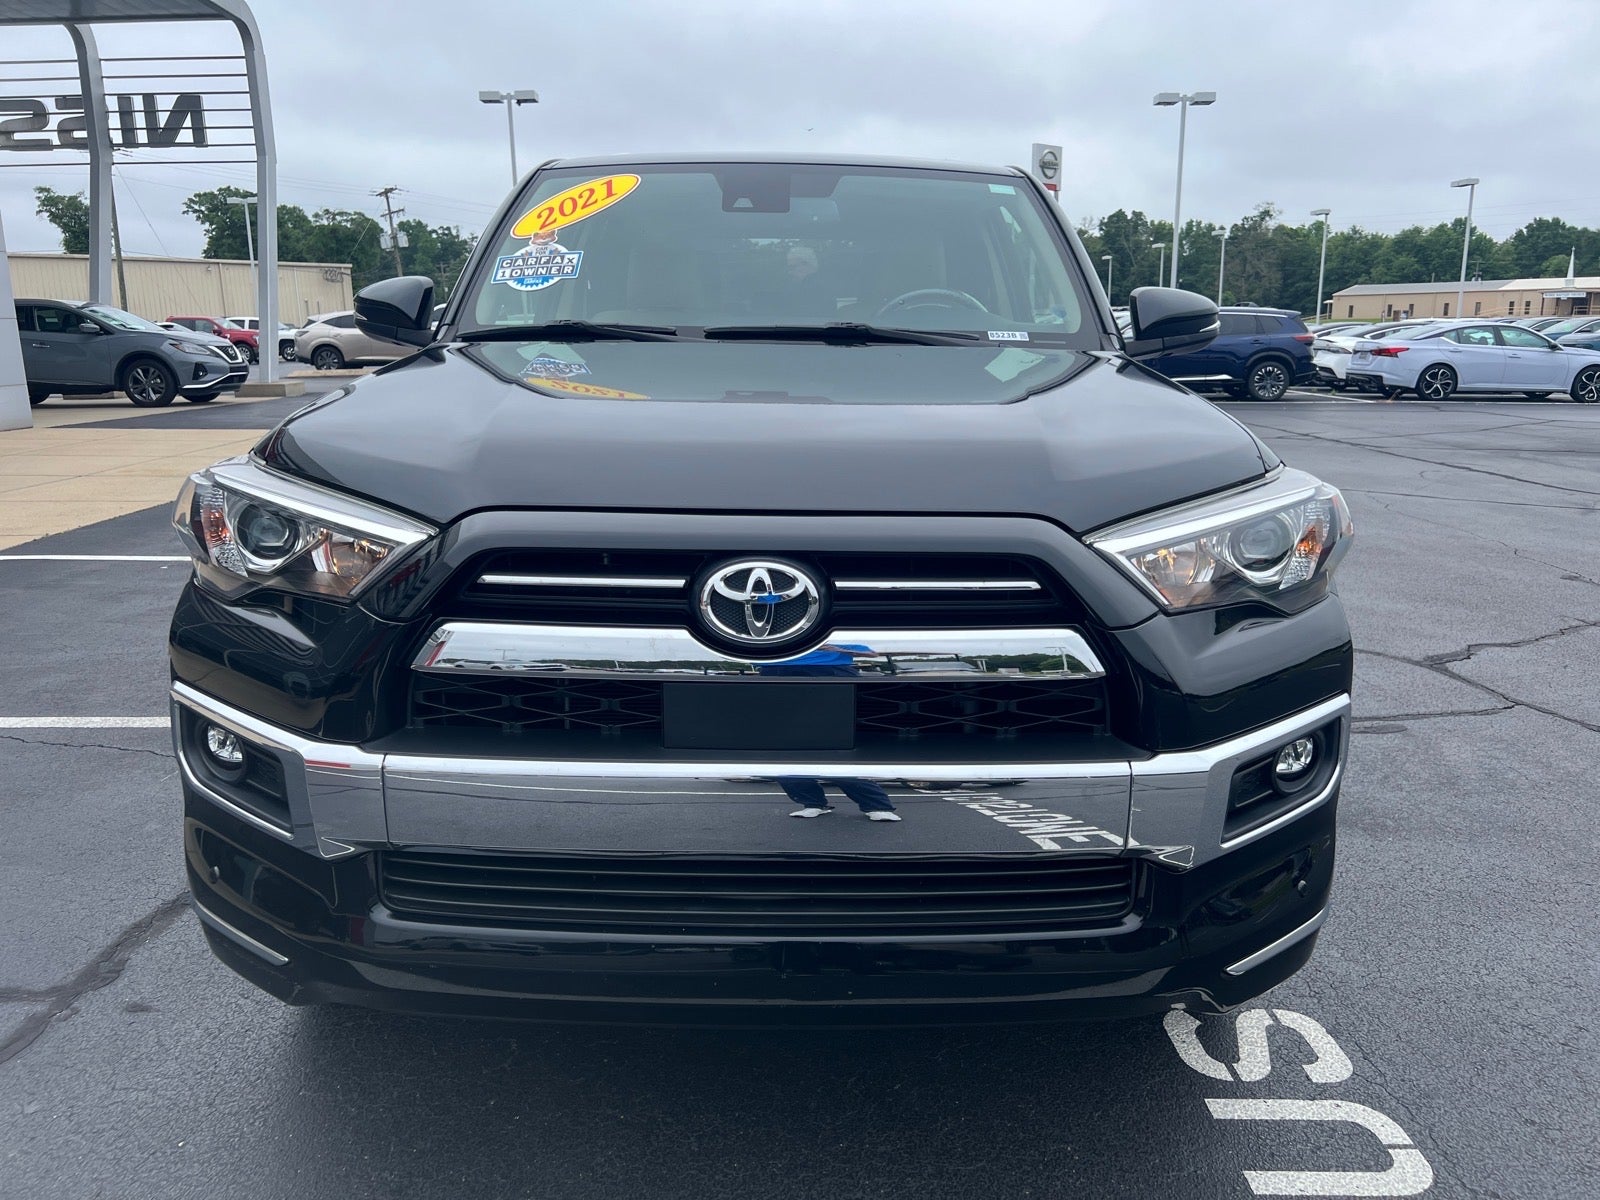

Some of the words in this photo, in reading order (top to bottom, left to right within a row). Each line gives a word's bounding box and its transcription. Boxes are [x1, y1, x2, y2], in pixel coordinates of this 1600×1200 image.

[536, 179, 618, 231] 2021
[502, 256, 576, 268] CARFAX
[499, 270, 507, 278] 1
[511, 266, 573, 277] OWNER
